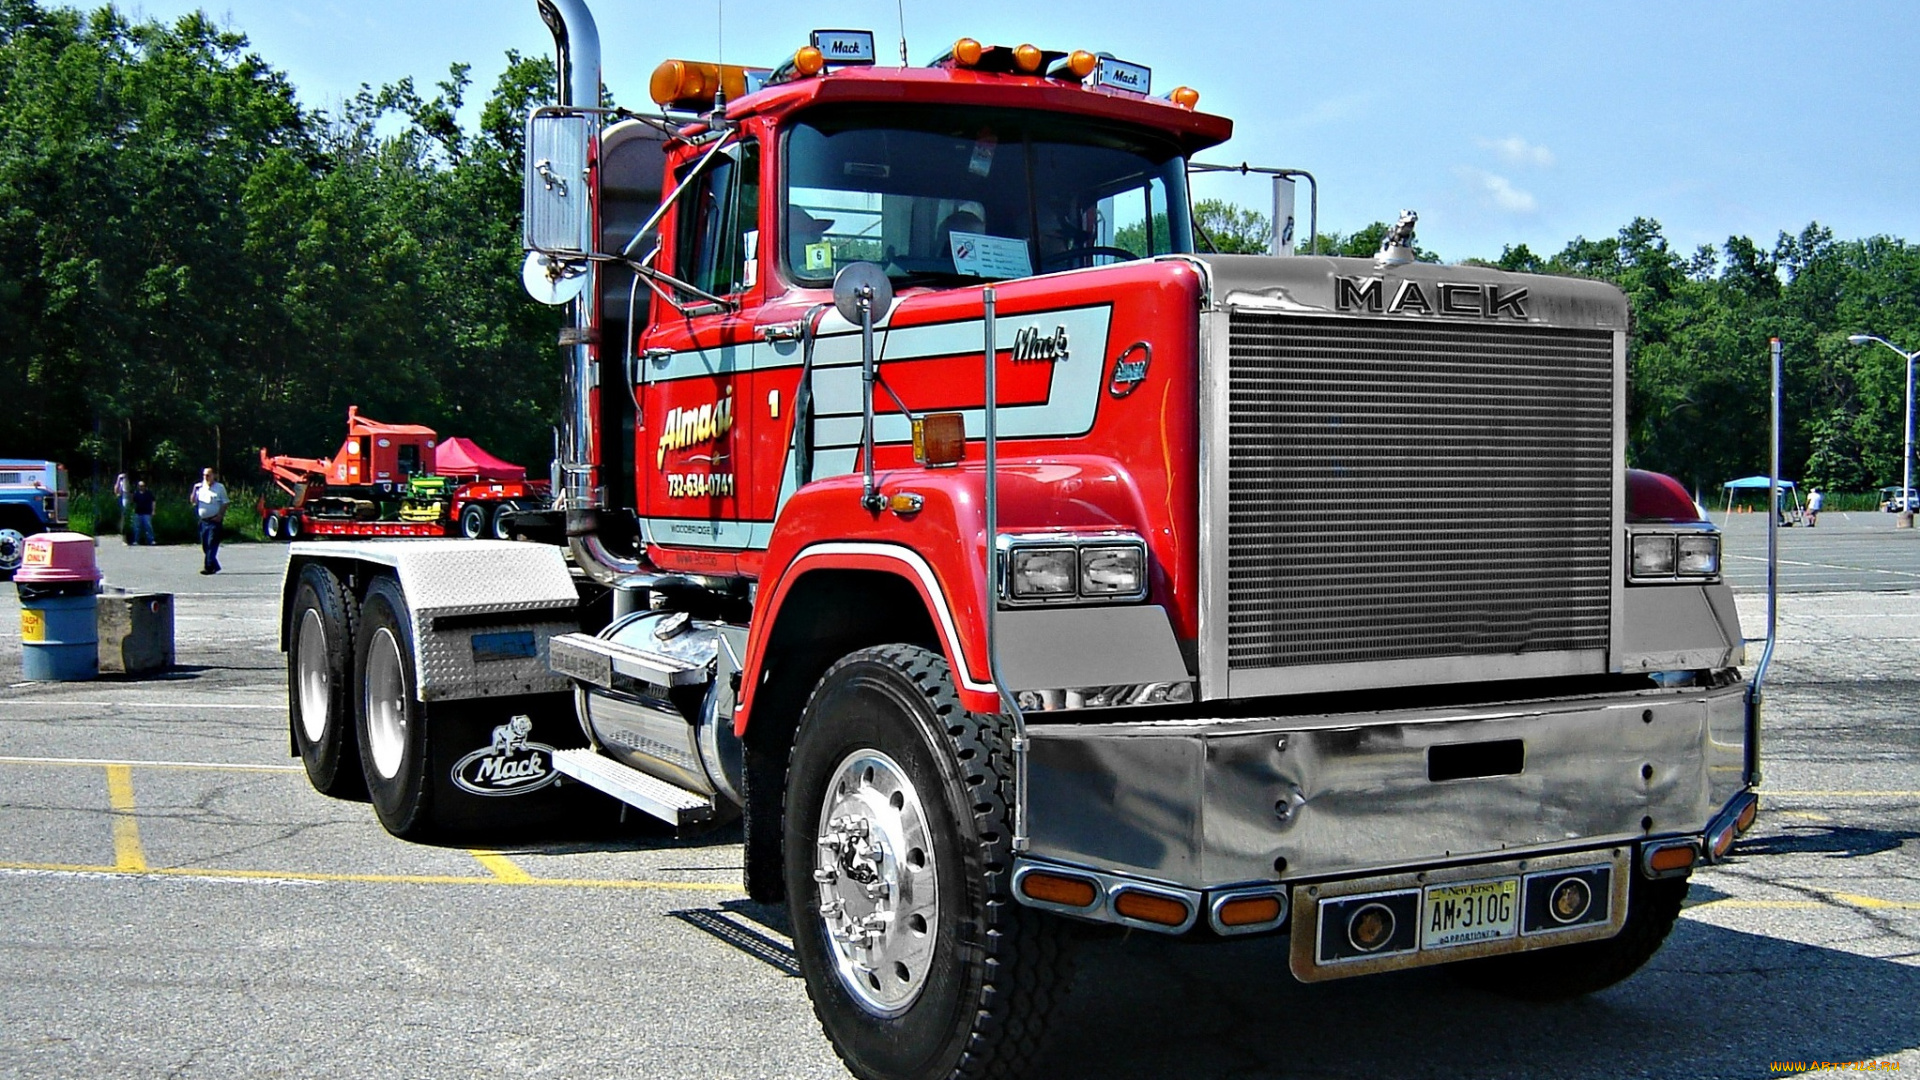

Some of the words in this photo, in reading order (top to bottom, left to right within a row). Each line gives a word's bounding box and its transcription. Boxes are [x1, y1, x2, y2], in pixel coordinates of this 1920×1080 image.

[831, 40, 860, 54] Mack
[1112, 69, 1138, 86] Mack
[816, 250, 822, 260] 6
[1335, 274, 1528, 320] MACK
[1011, 325, 1070, 362] Mack
[768, 389, 780, 418] 1
[667, 473, 734, 497] 732-634-0741
[474, 752, 546, 785] Mack
[1448, 886, 1467, 897] New
[1468, 884, 1494, 896] Jersey
